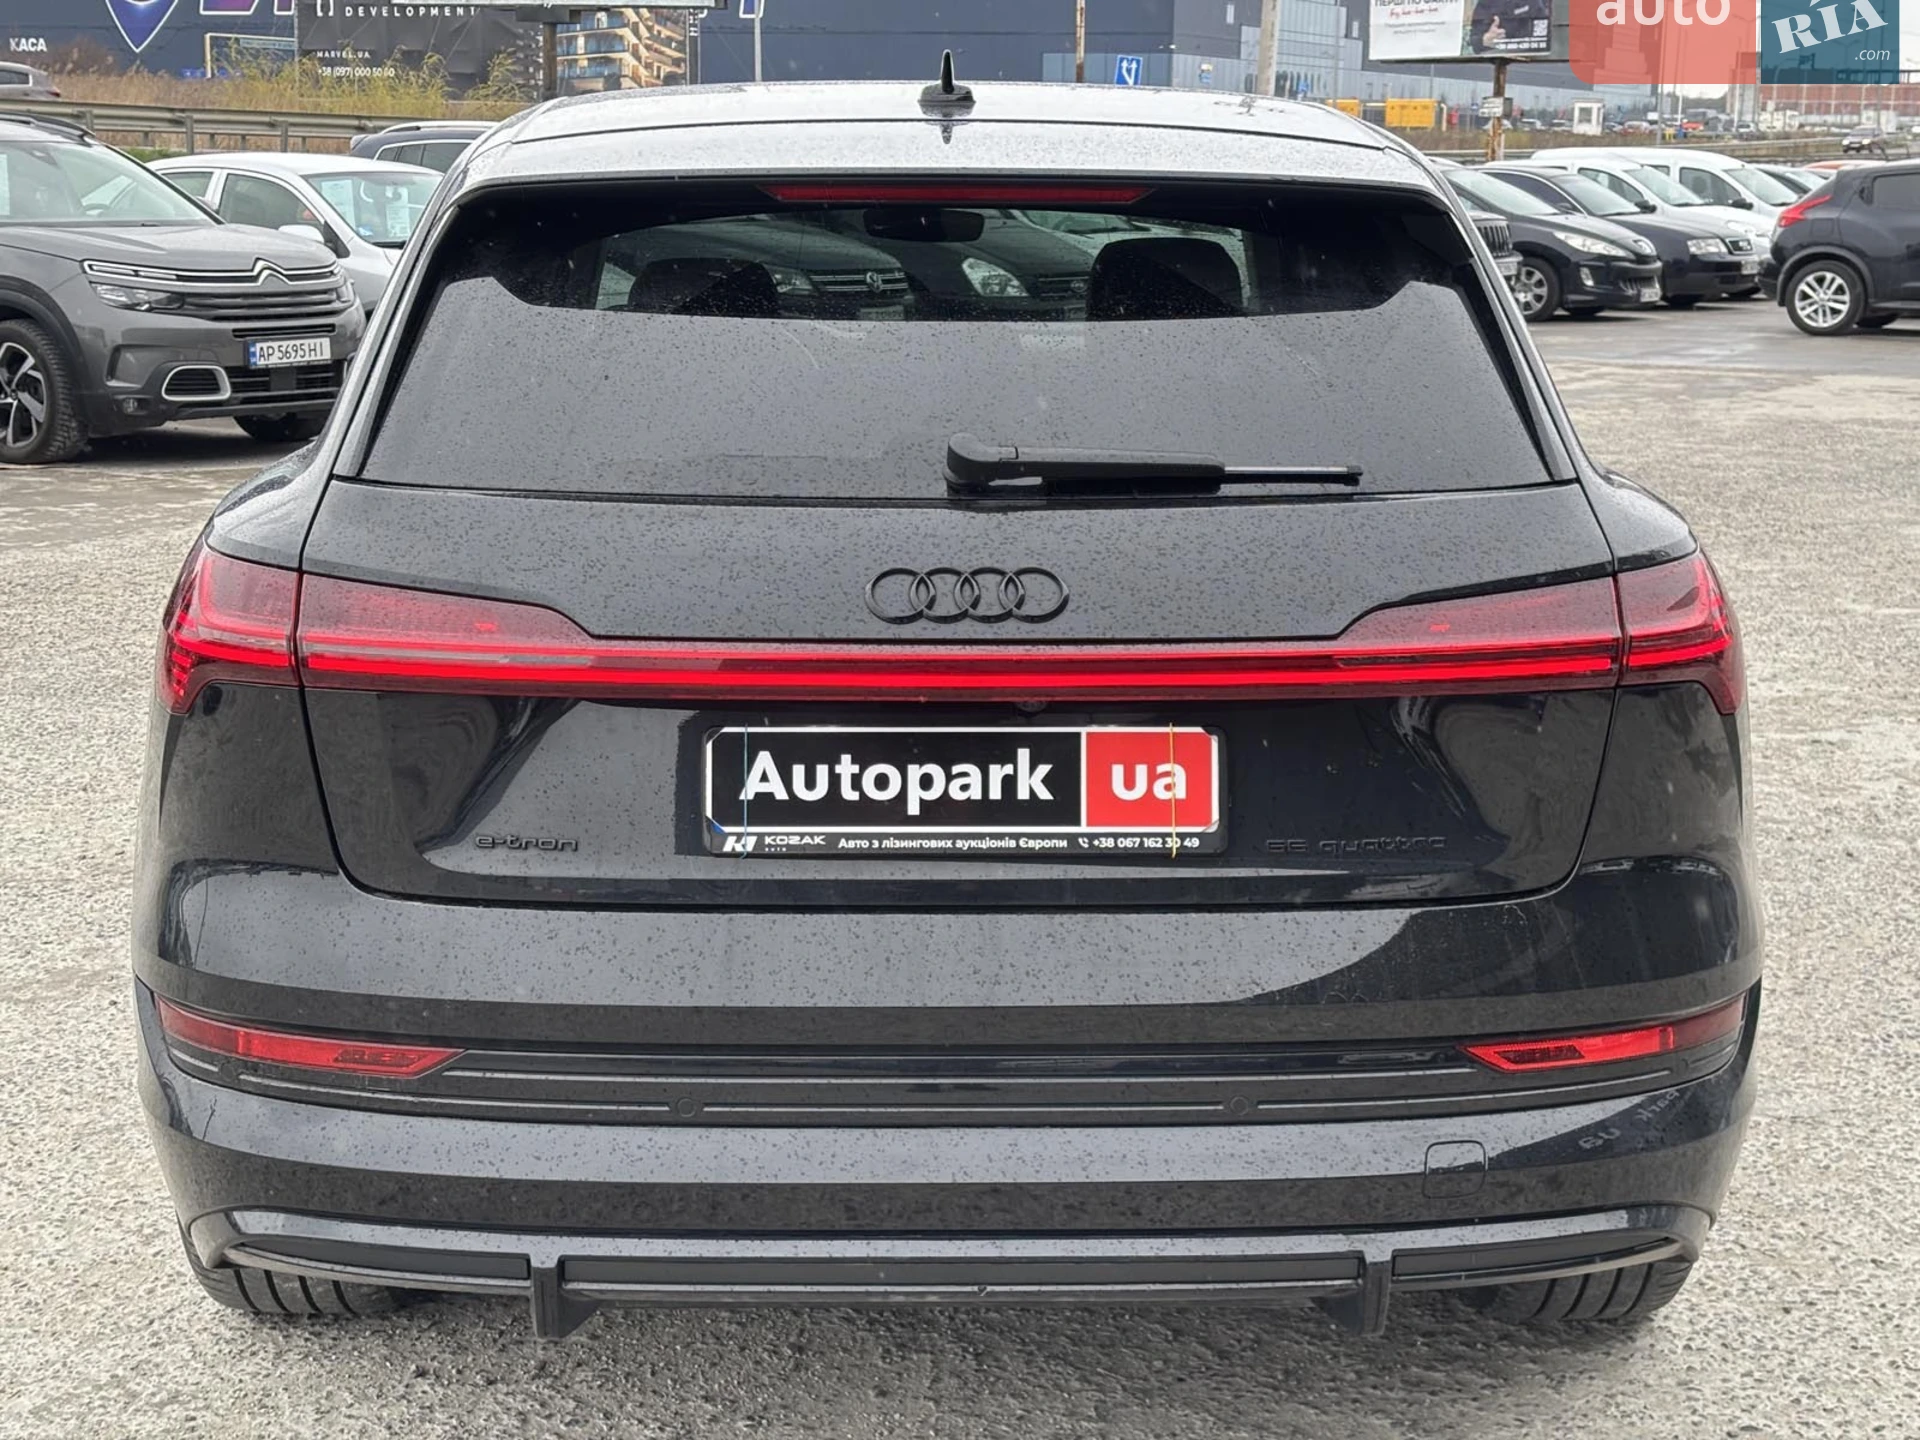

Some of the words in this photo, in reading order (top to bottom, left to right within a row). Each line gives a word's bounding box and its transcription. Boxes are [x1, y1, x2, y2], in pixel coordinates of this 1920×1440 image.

[345, 6, 476, 17] DEVELOPMENT
[316, 51, 371, 59] MARVEL.UA
[354, 66, 372, 77] 000
[739, 748, 1053, 816] Autopark
[1110, 762, 1188, 800] ua
[475, 834, 579, 852] e-tron
[838, 837, 870, 849] Авто
[882, 837, 954, 849] лізингових
[955, 837, 1017, 851] аукціонів
[1019, 837, 1068, 851] Європи
[1092, 837, 1115, 848] +38
[1117, 837, 1140, 848] 067
[1143, 837, 1163, 848] 162
[1183, 837, 1200, 848] 49
[1319, 836, 1447, 857] quattro
